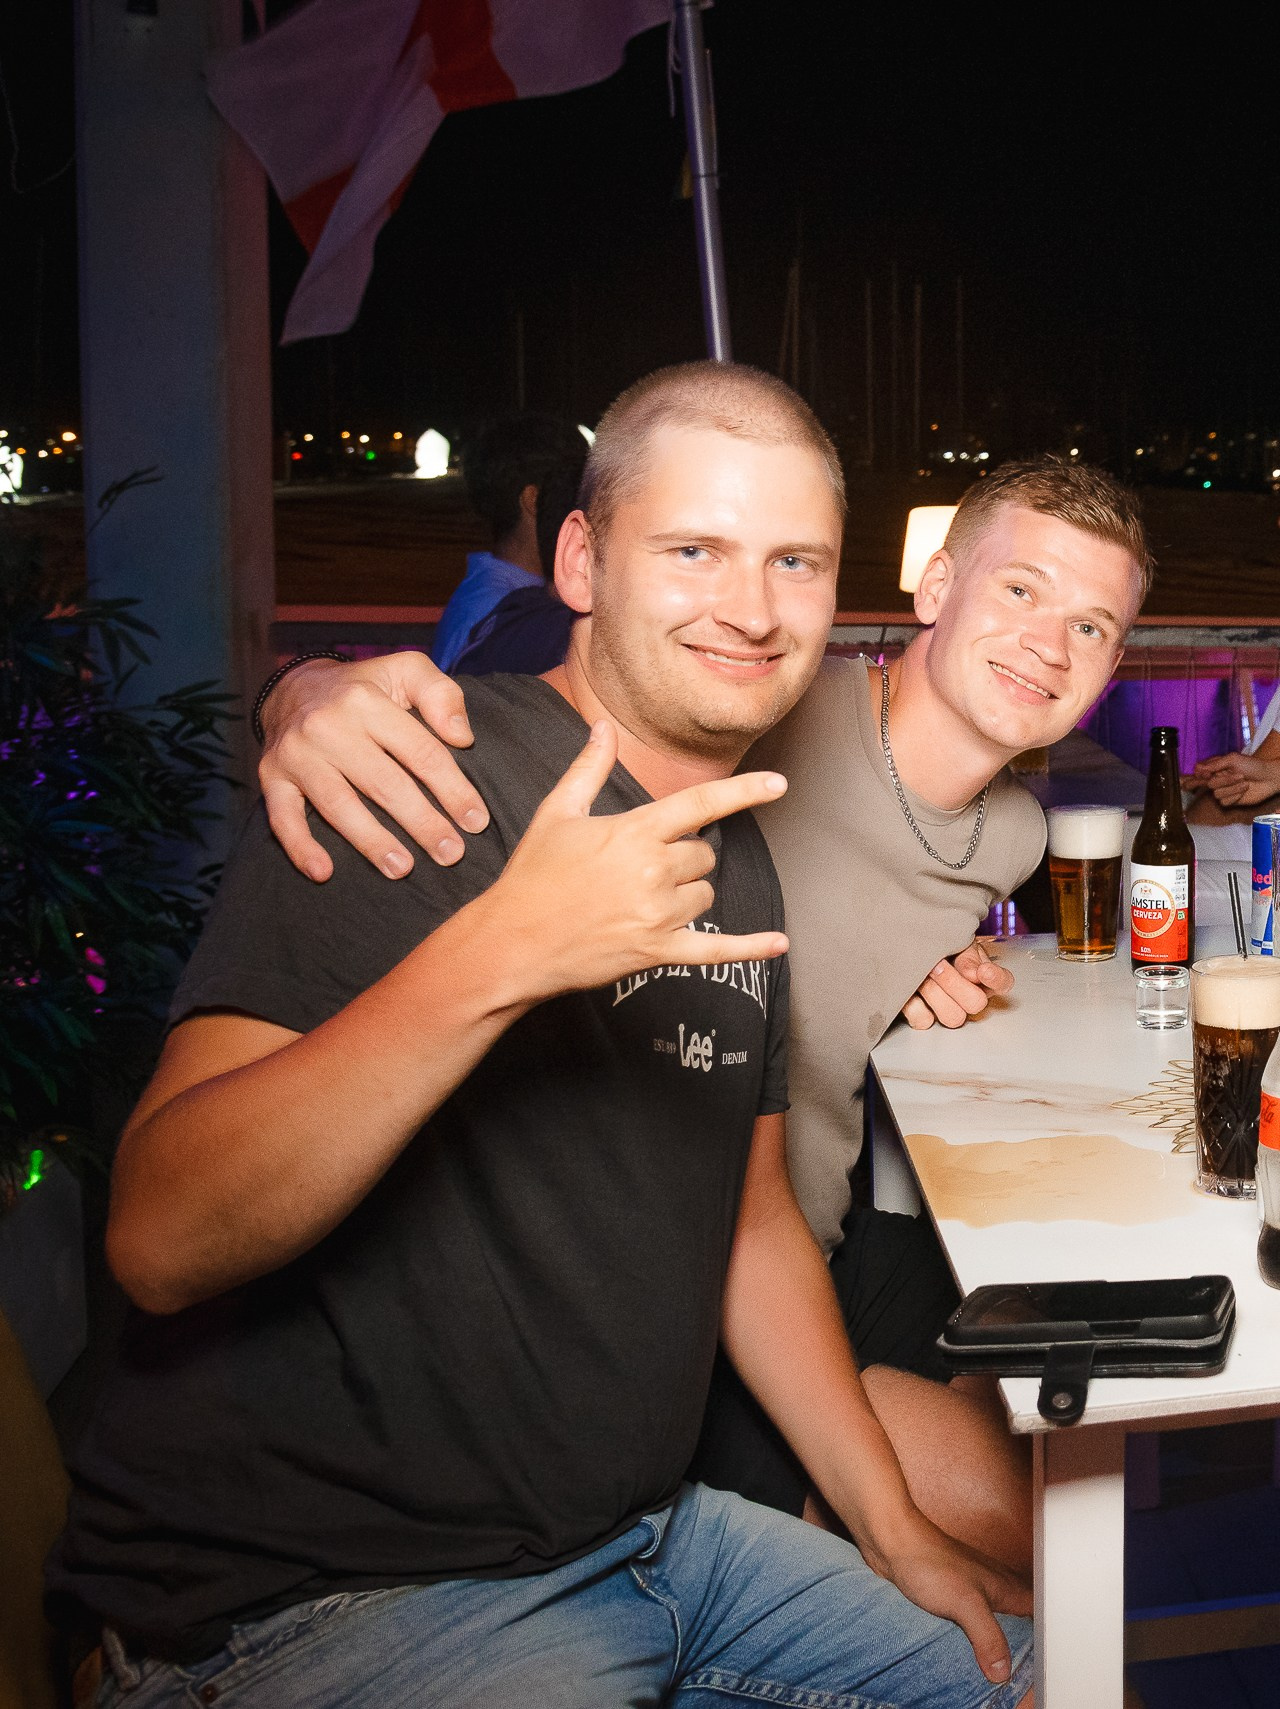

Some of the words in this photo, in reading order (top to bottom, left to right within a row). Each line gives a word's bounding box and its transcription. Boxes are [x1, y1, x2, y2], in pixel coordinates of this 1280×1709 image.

[1131, 897, 1168, 909] AMSTEL
[1133, 909, 1163, 920] CERVEZA
[721, 1051, 748, 1065] DENIM
